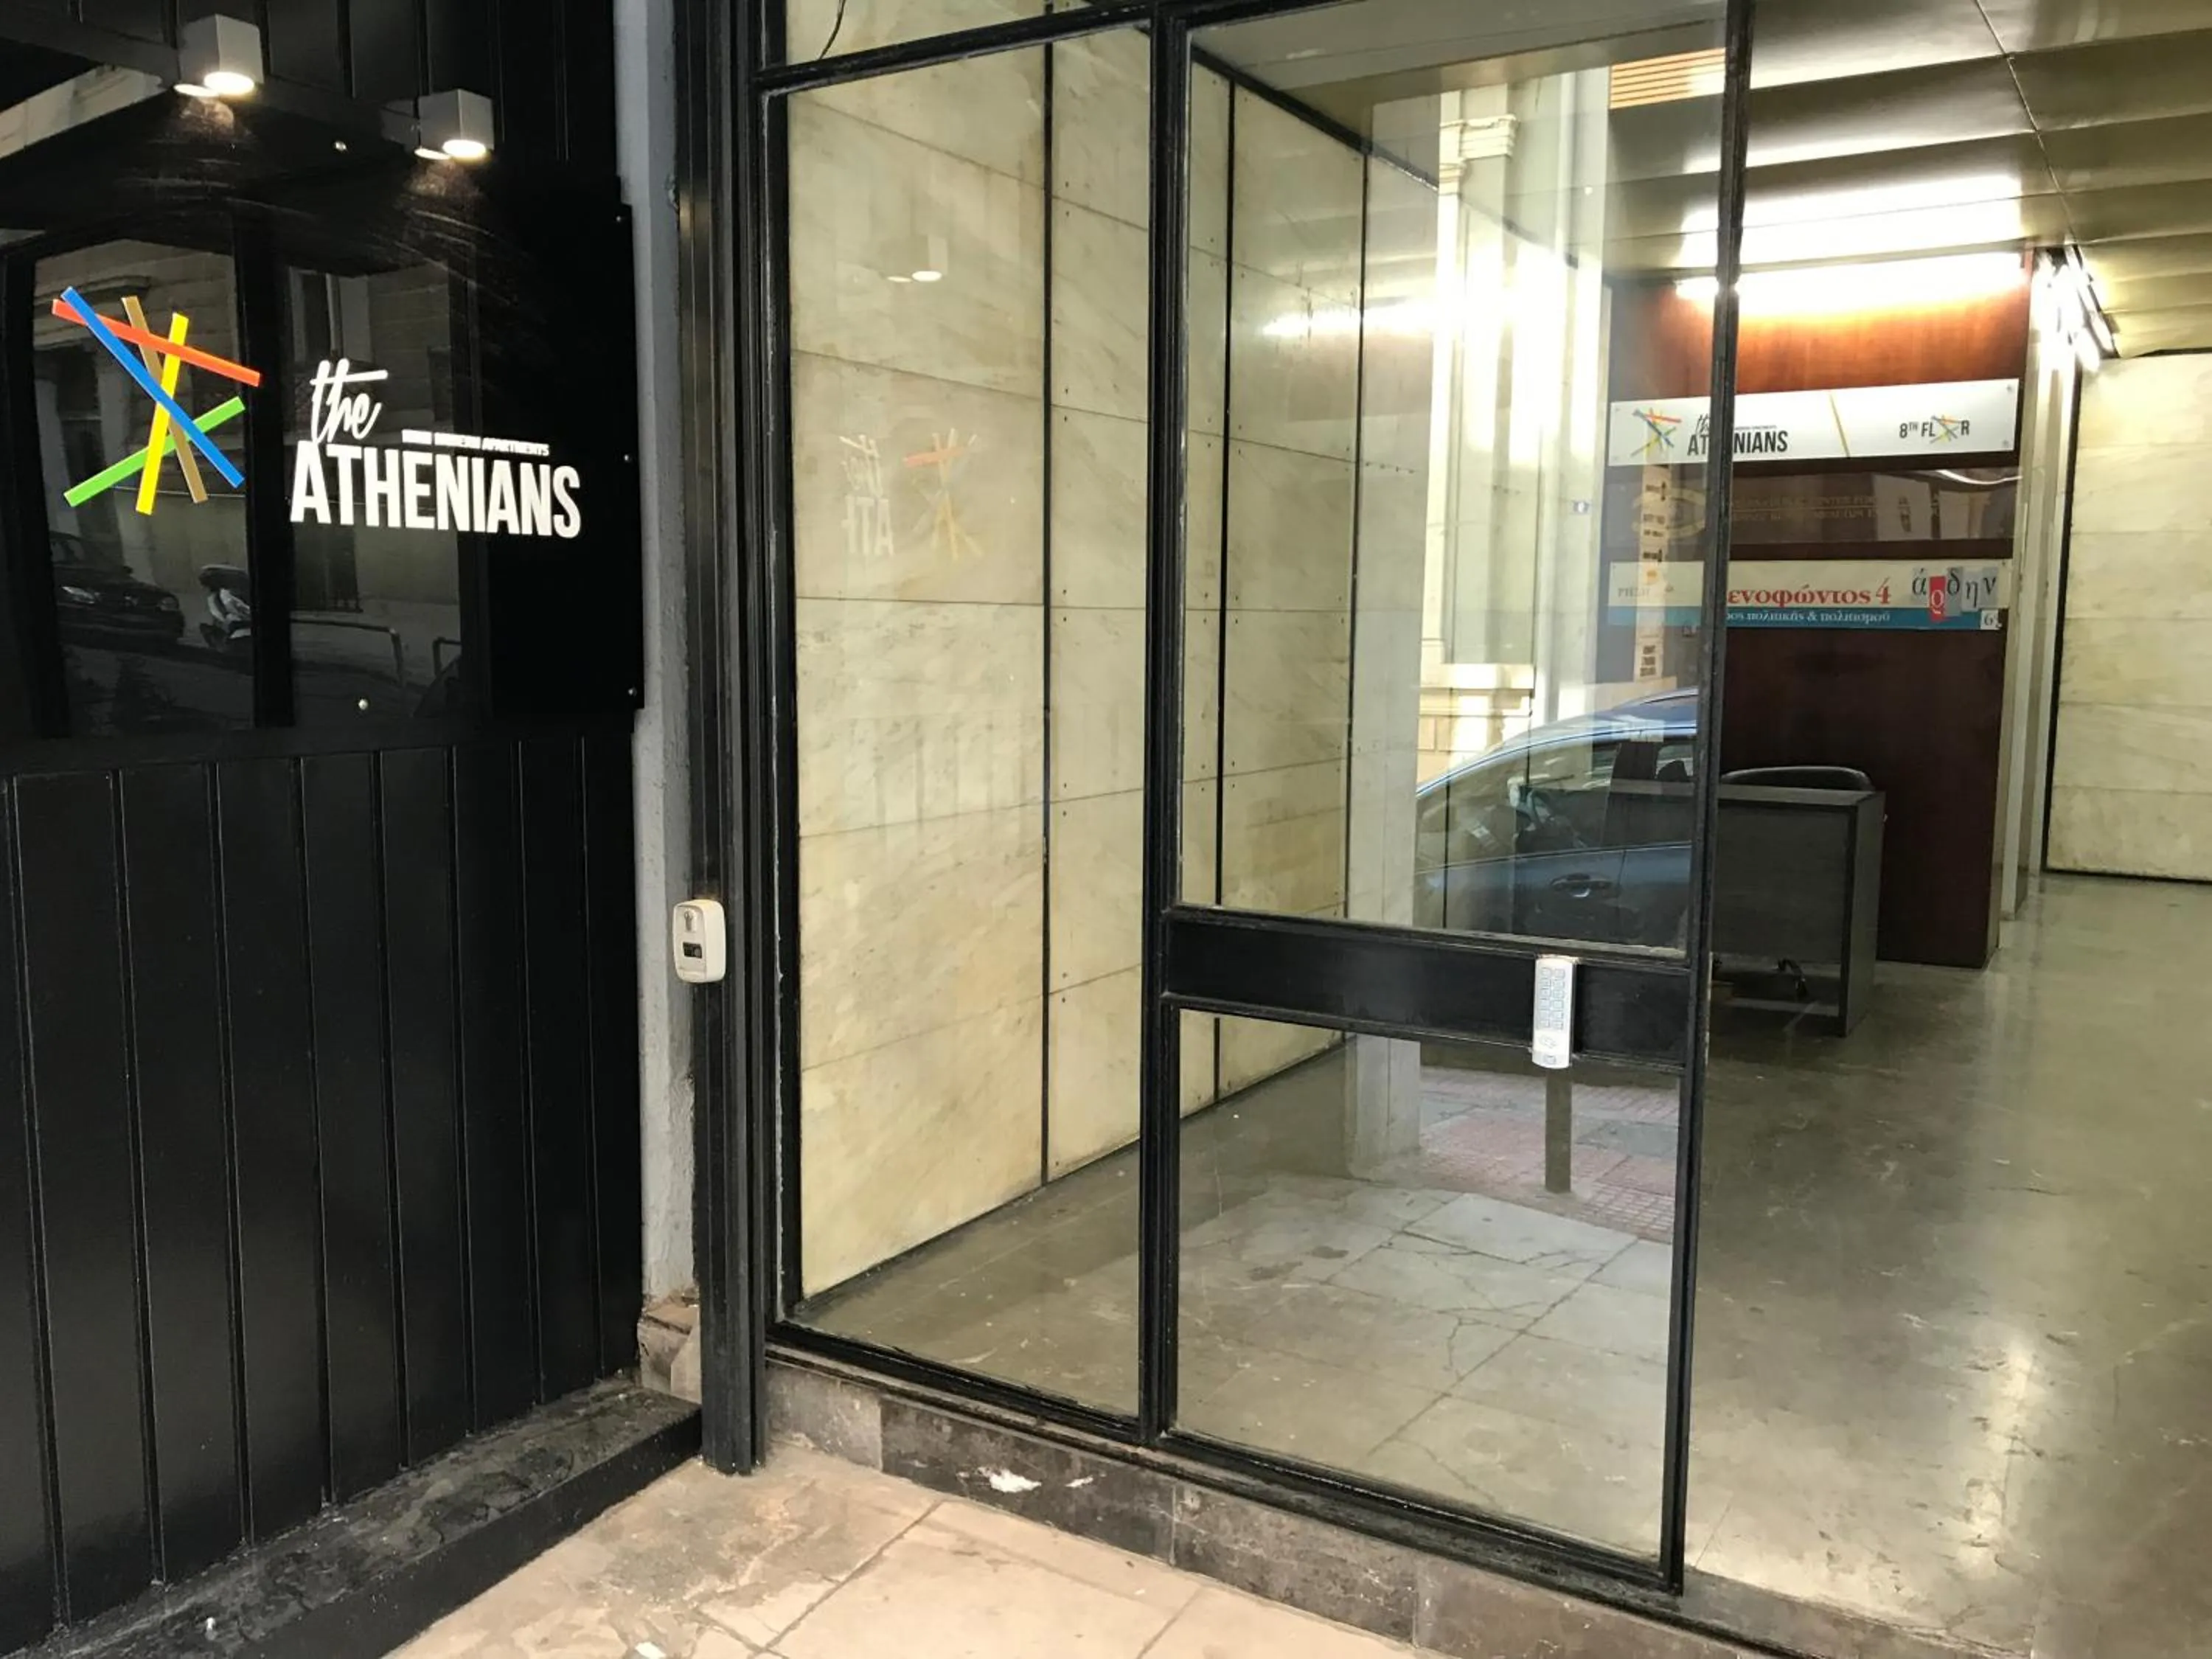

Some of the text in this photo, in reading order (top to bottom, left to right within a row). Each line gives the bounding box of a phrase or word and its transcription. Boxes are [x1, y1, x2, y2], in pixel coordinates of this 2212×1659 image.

[310, 358, 389, 443] the
[1687, 430, 1788, 456] ATNIANS
[291, 440, 582, 539] ATHENIANS
[1727, 577, 1891, 608] ενοφώντος 4
